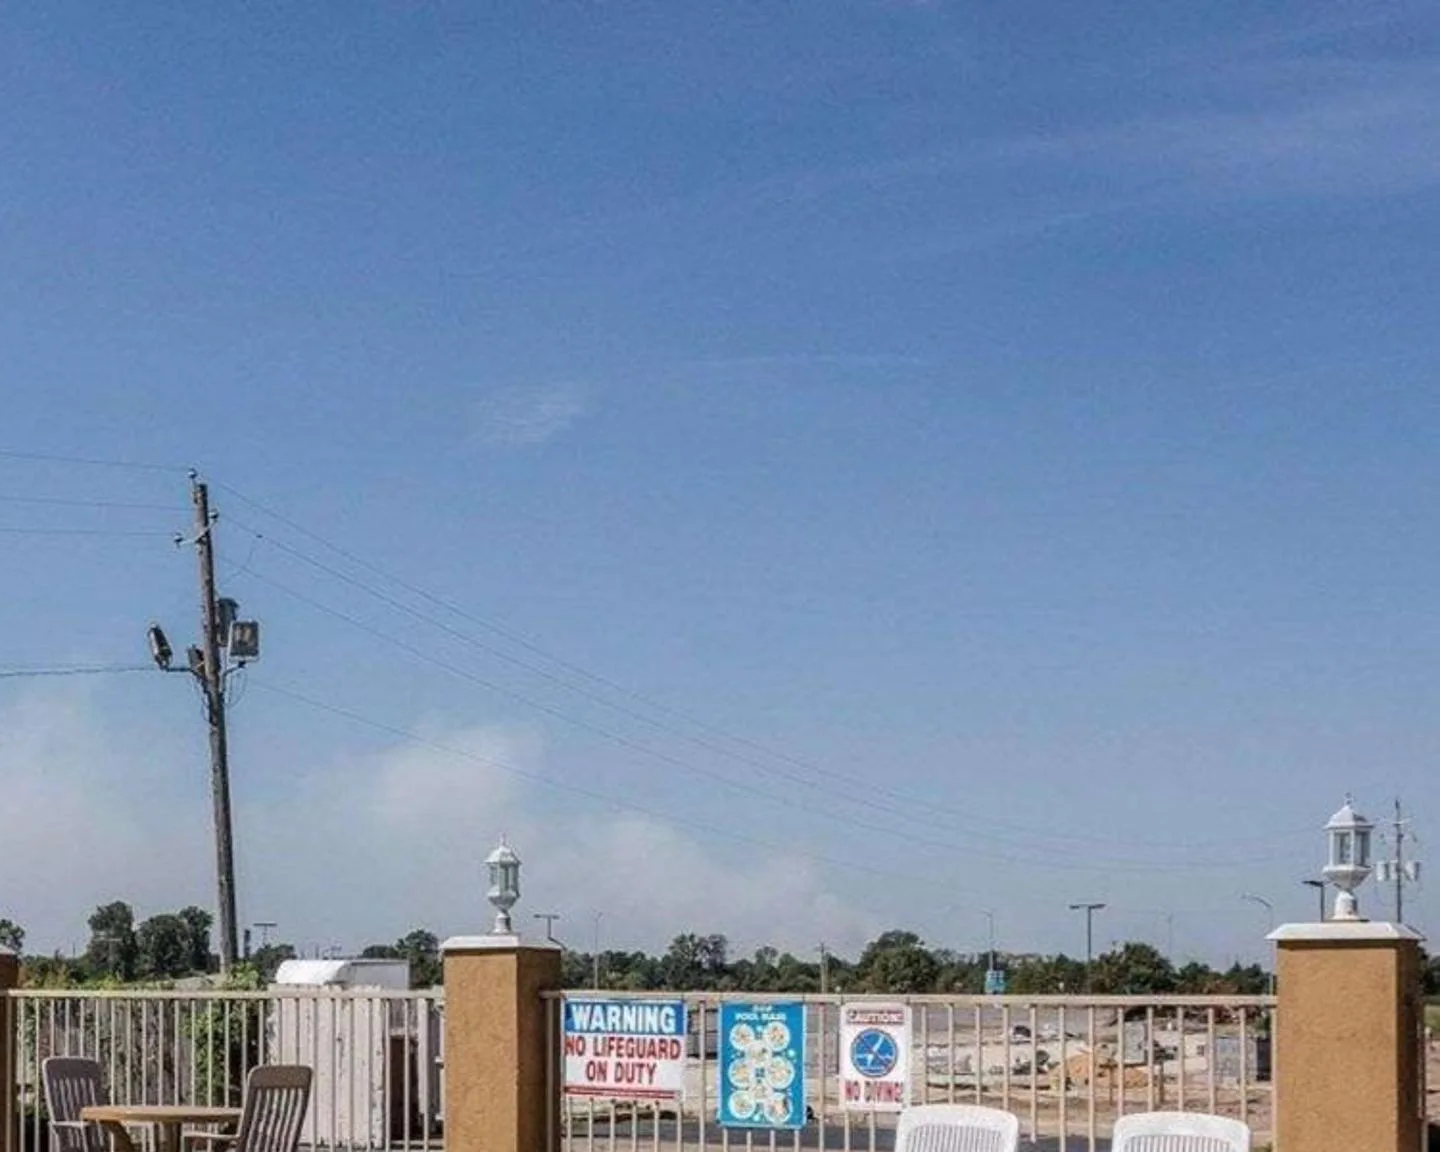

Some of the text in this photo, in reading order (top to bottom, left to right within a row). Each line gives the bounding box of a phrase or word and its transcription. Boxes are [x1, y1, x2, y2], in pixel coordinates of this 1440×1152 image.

[571, 1004, 676, 1033] WARNING
[565, 1035, 681, 1060] NO LIFEGUARD
[586, 1060, 657, 1084] ON DUTY
[844, 1081, 861, 1101] NO
